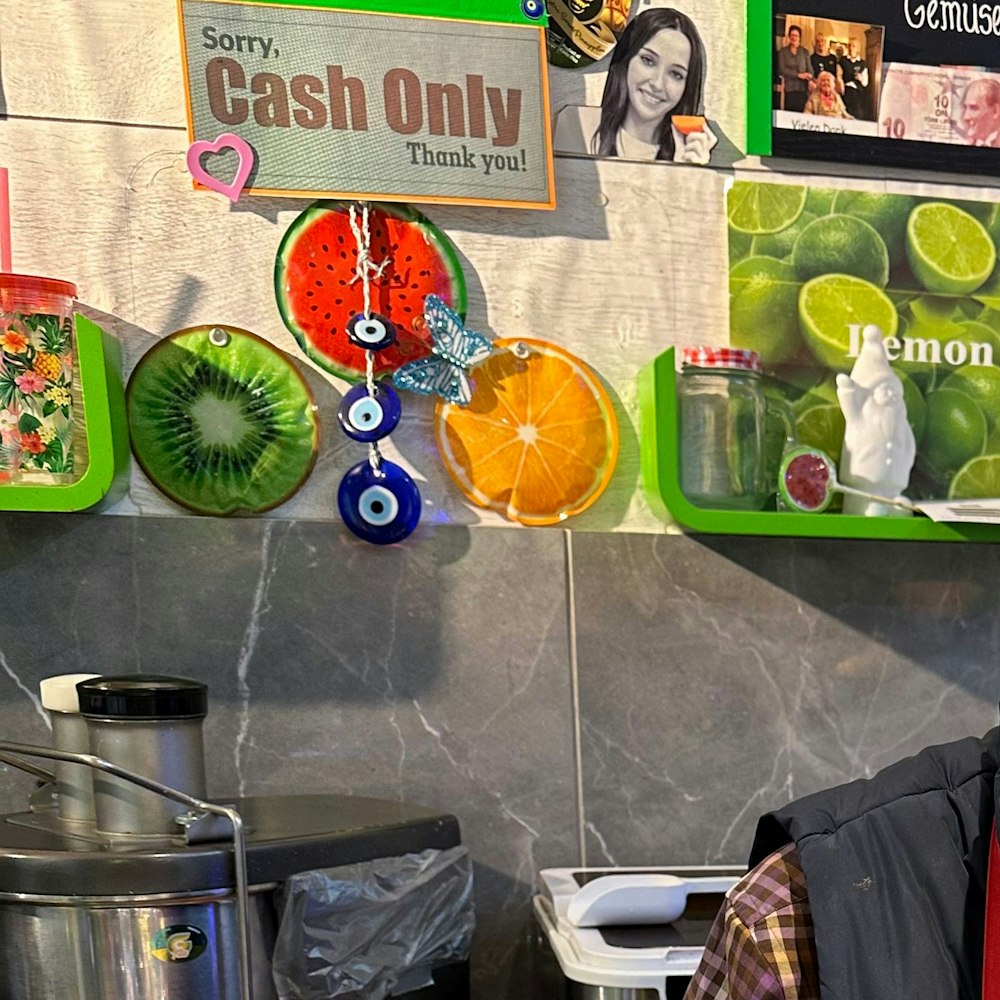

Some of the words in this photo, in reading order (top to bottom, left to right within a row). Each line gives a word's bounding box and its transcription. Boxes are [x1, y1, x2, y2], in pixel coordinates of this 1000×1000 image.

[202, 26, 280, 58] Sorry,
[205, 56, 369, 131] Cash
[383, 67, 522, 147] Only
[935, 95, 949, 109] 10
[883, 117, 906, 139] 10
[406, 142, 477, 169] Thank
[481, 149, 528, 175] you!
